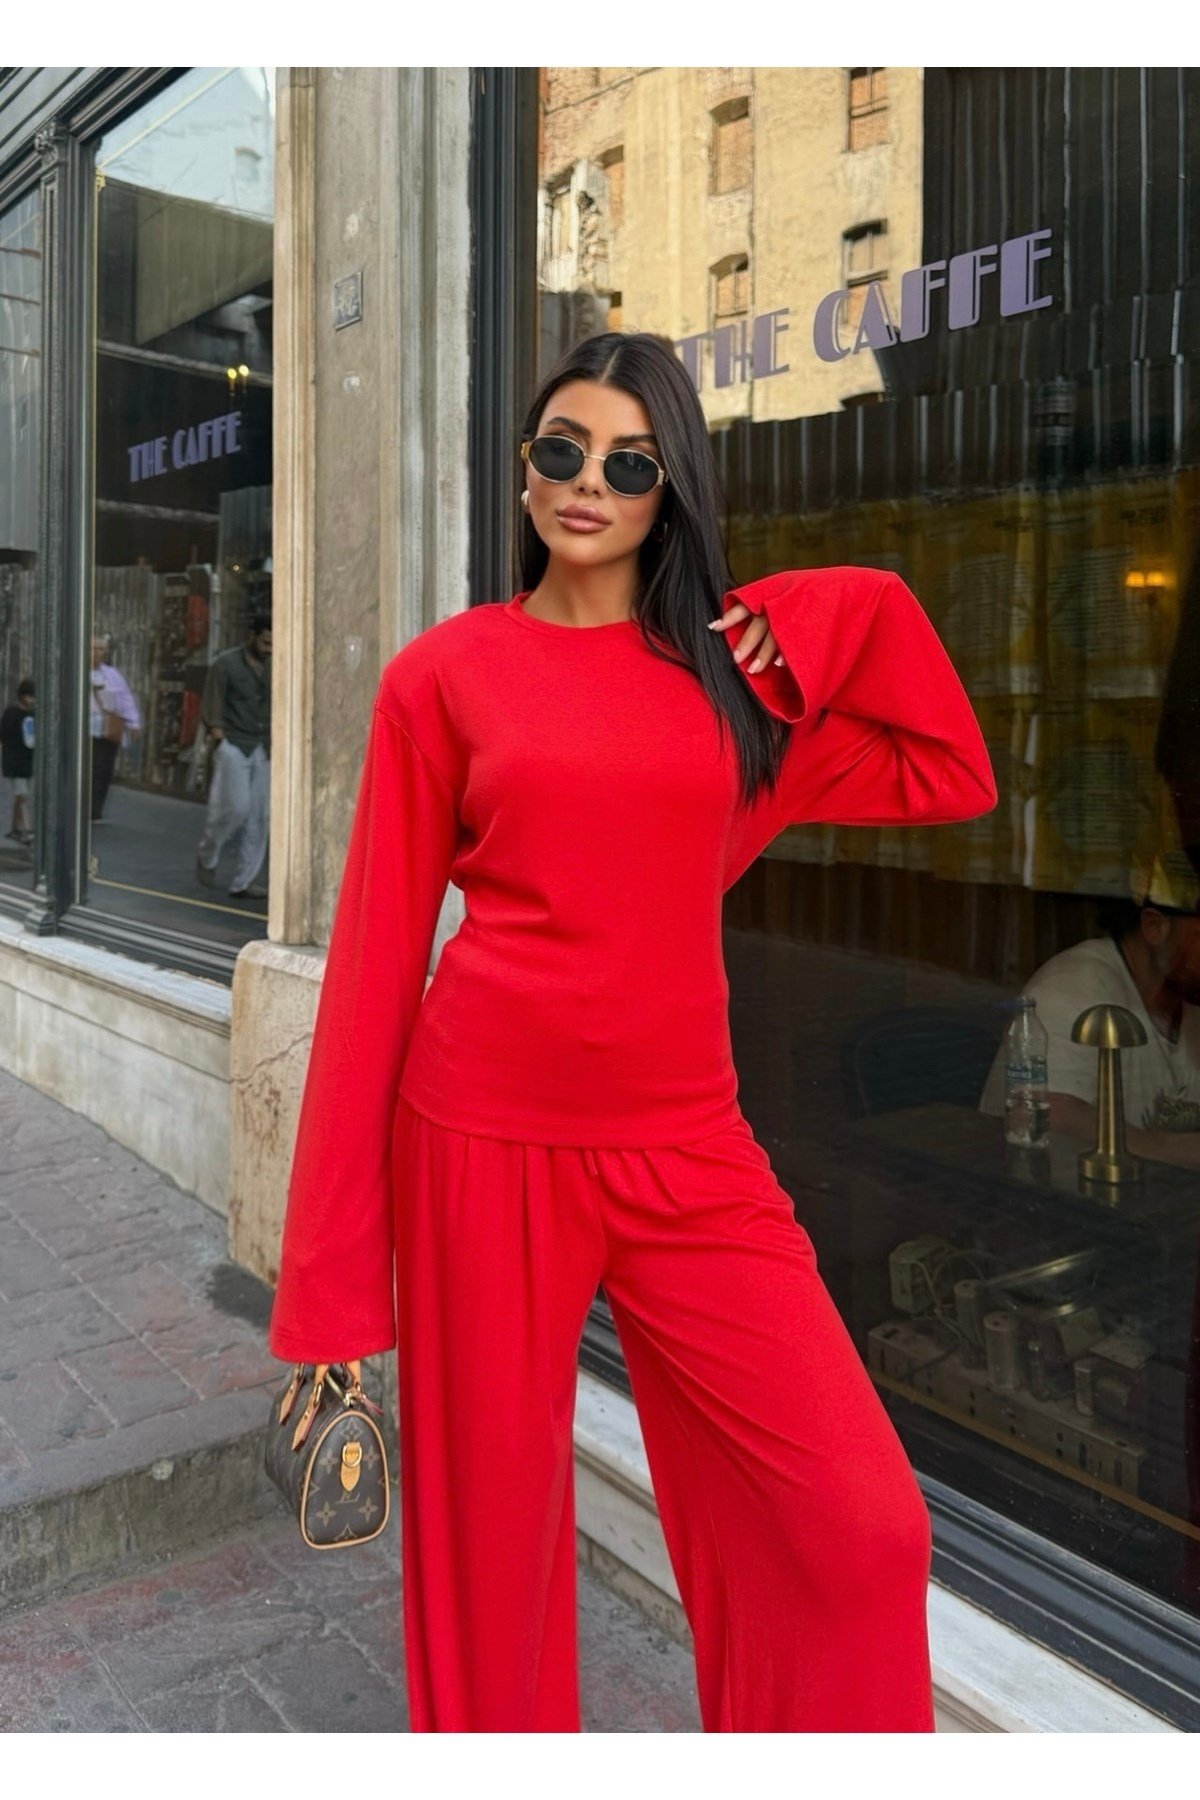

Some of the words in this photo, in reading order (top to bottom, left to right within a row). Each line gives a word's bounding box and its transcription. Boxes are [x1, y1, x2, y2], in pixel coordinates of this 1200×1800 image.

[676, 308, 790, 394] THE
[813, 229, 1052, 362] CAFFE
[127, 436, 168, 482] THE
[172, 410, 242, 470] CAFFE
